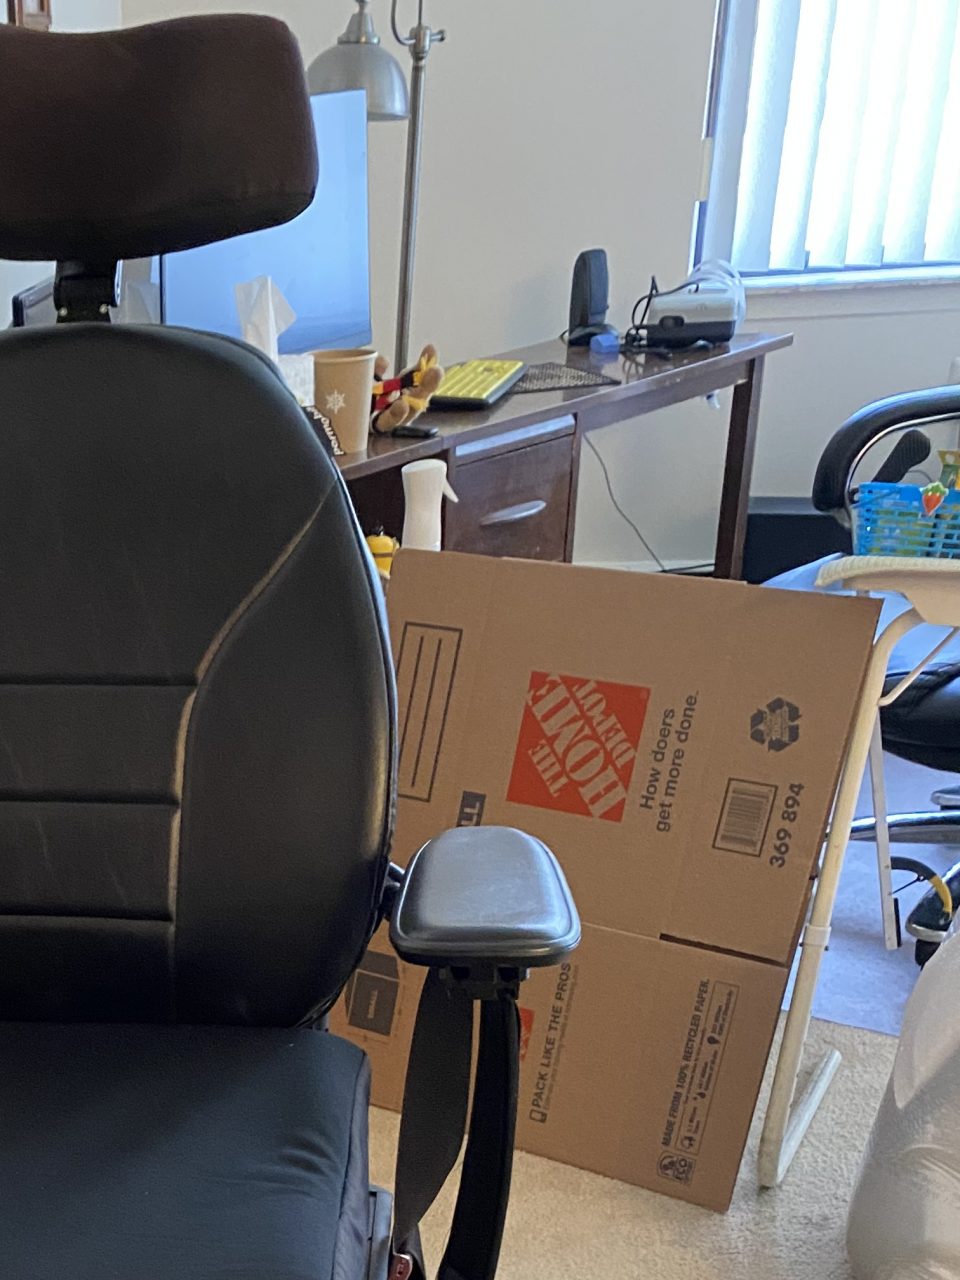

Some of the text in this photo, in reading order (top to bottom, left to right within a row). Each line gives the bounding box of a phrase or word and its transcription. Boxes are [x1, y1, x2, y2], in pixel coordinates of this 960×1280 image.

[526, 672, 627, 819] HOME
[529, 739, 569, 797] THE
[573, 679, 636, 768] DEPOT
[639, 707, 676, 810] How doers
[656, 690, 699, 833] get more done.
[769, 782, 805, 869] 369 894
[534, 962, 571, 1107] PACK LIKE THE PROS
[662, 1119, 675, 1147] MADE
[669, 1088, 682, 1117] FROM
[676, 1063, 688, 1087] 100%
[683, 1013, 701, 1062] RECYCLED
